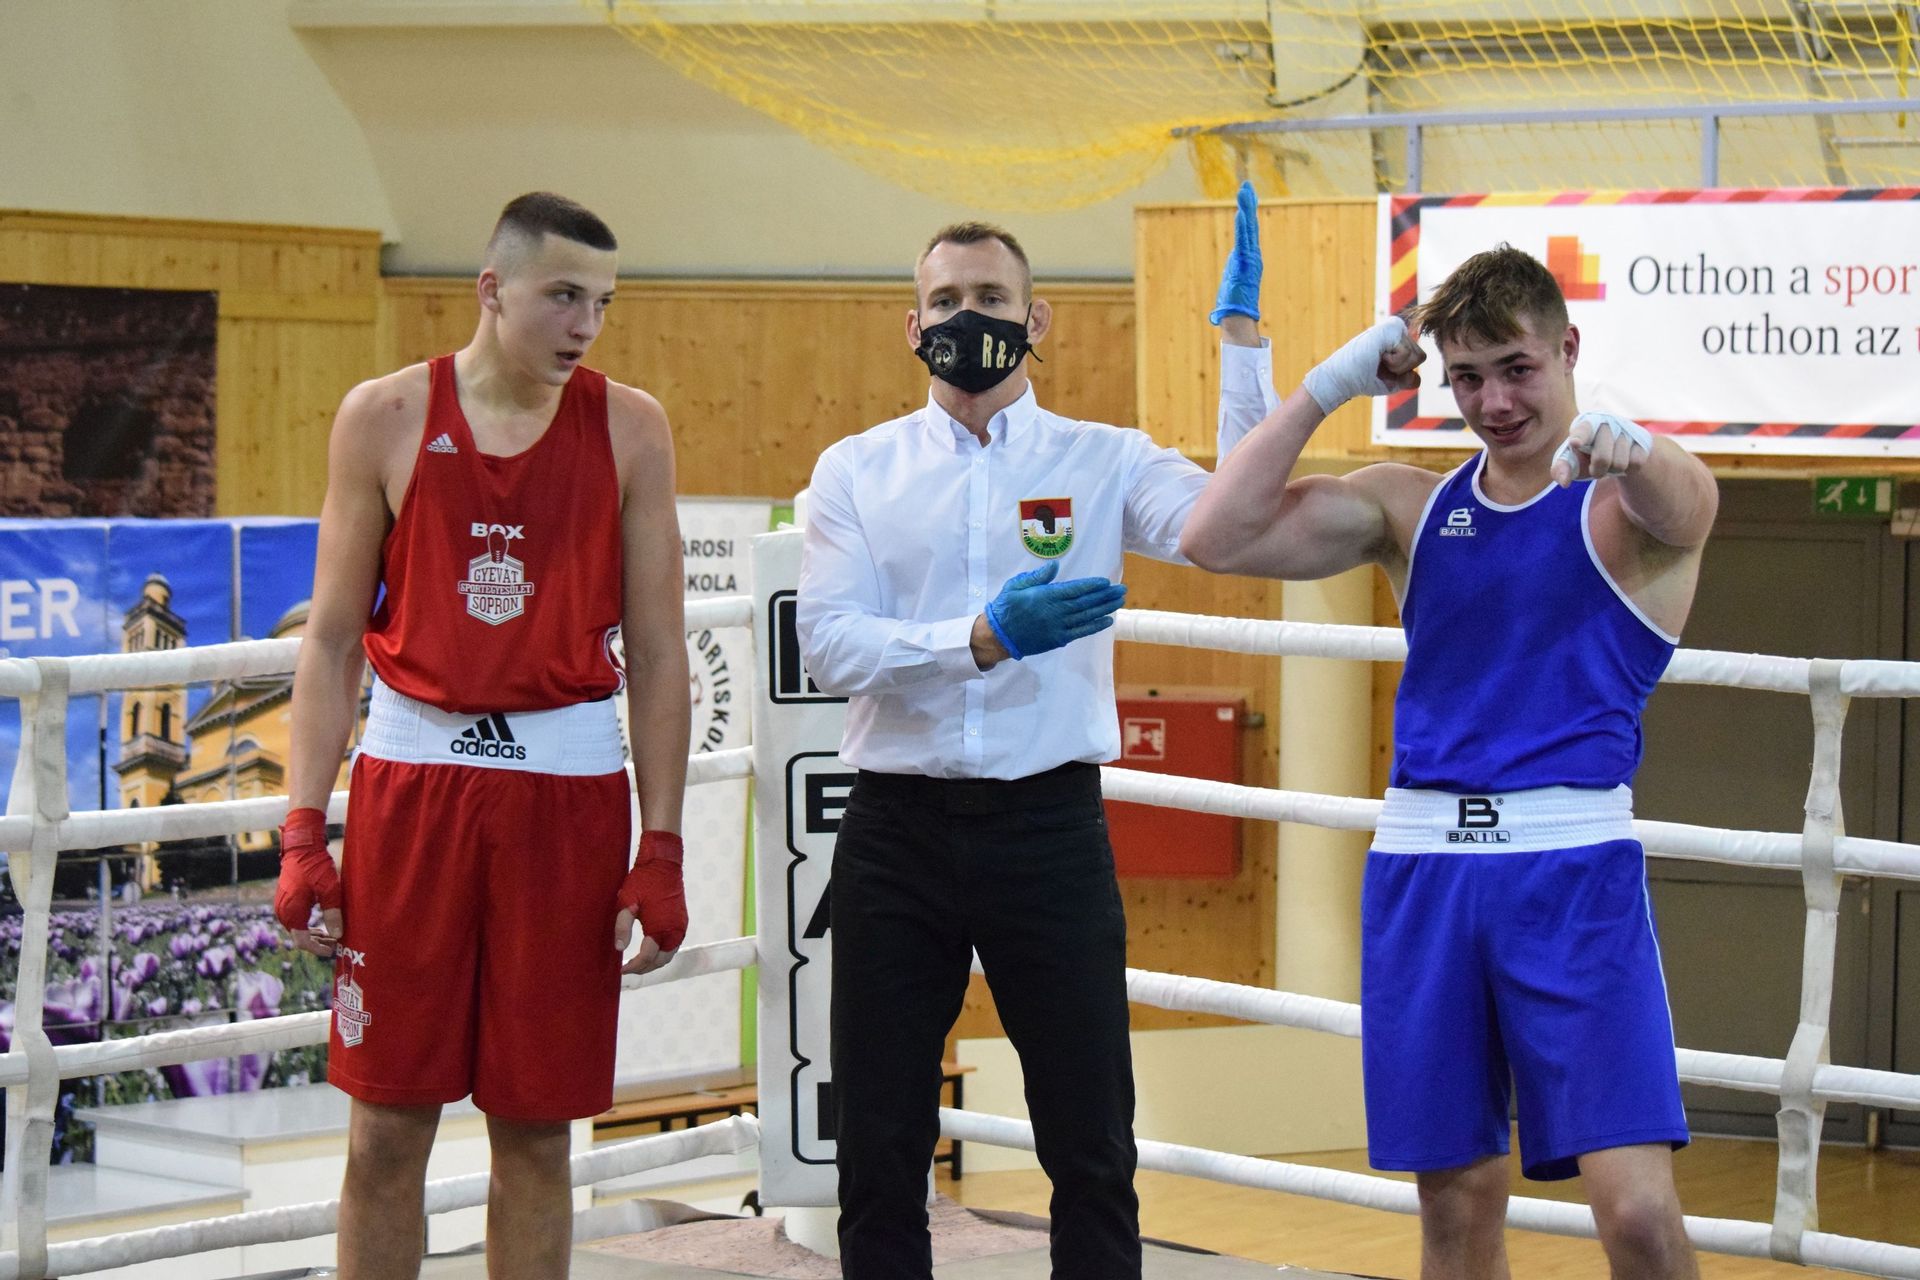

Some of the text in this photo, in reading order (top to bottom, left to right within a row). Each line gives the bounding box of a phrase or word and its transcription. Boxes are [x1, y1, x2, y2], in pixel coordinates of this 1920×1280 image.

[1629, 252, 1775, 296] Otthon
[1790, 264, 1811, 295] a
[1702, 312, 1841, 356] otthon
[1855, 326, 1901, 356] az
[427, 444, 459, 454] adidas
[471, 523, 525, 540] BOX
[1441, 527, 1475, 536] BAIL
[473, 566, 519, 584] GYEVÁT
[685, 574, 738, 592] KOLA
[1, 578, 81, 641] ER
[472, 596, 519, 615] SOPRON
[450, 737, 527, 761] adidas
[1447, 832, 1508, 843] BAIL
